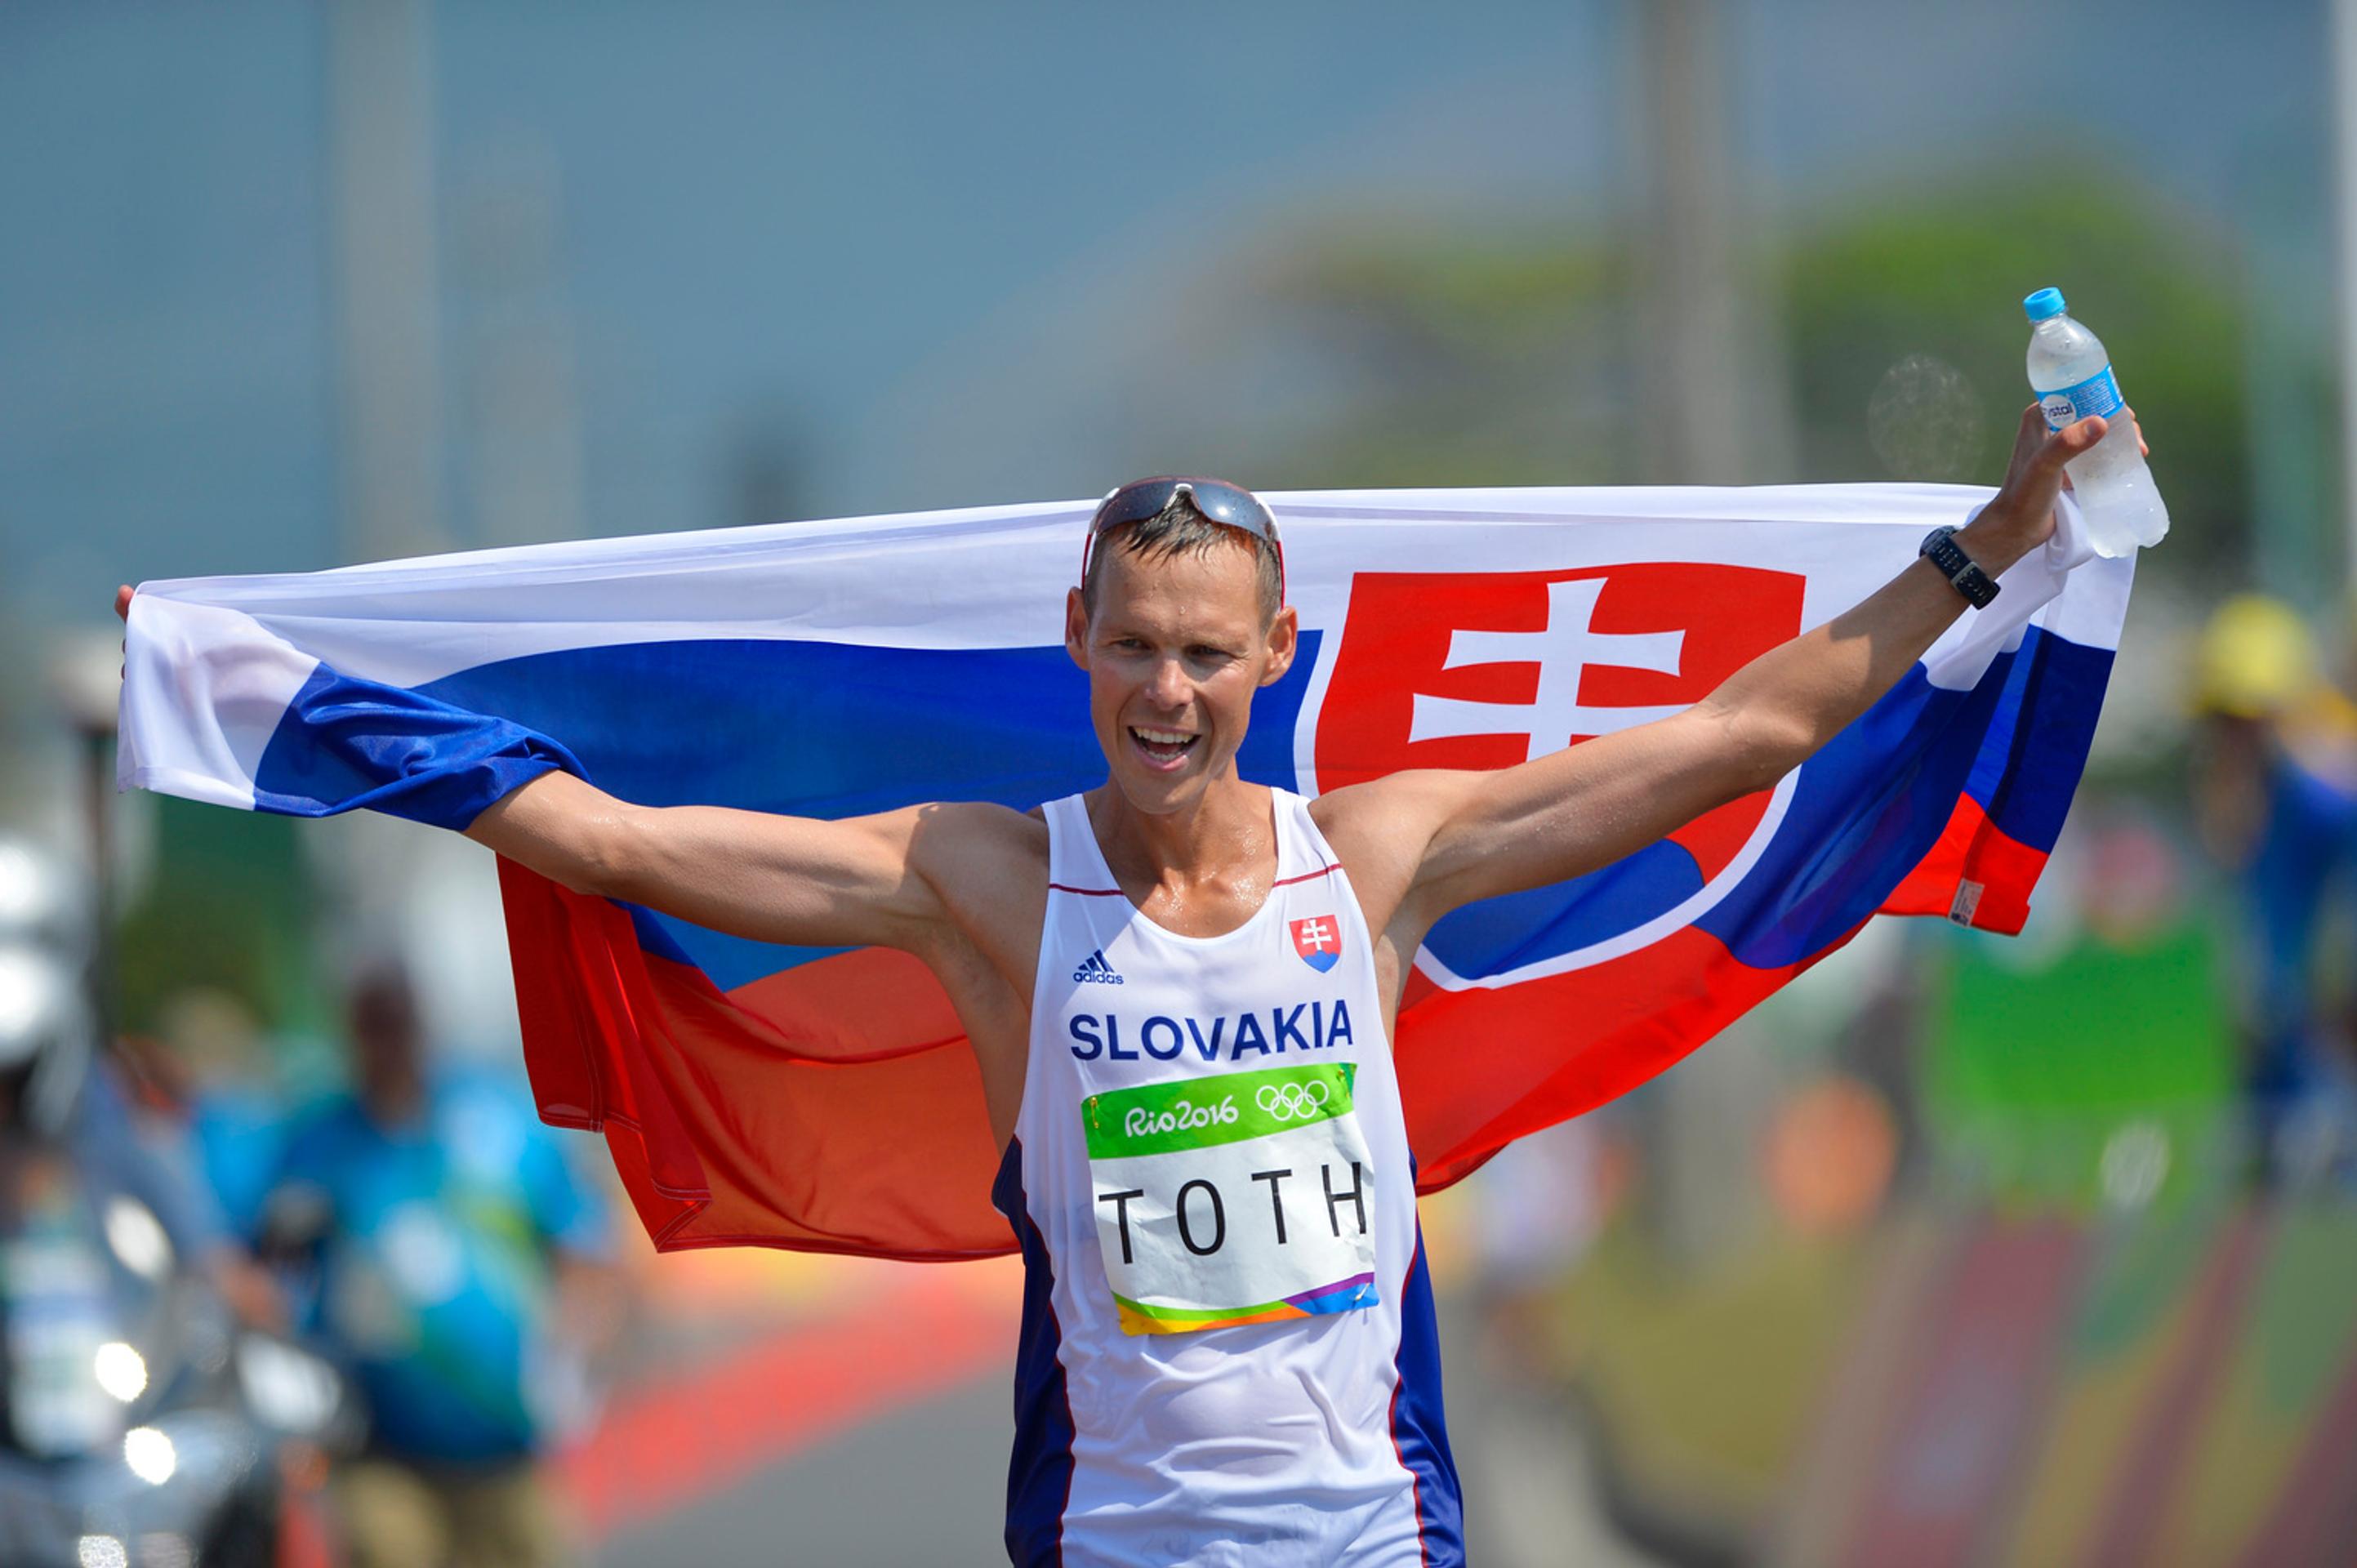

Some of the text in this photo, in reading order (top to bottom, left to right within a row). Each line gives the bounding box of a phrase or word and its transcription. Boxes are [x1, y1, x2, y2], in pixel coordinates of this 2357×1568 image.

[1073, 971, 1124, 984] adidas
[1069, 999, 1353, 1061] SLOVAKIA
[1098, 1161, 1367, 1265] TOTH
